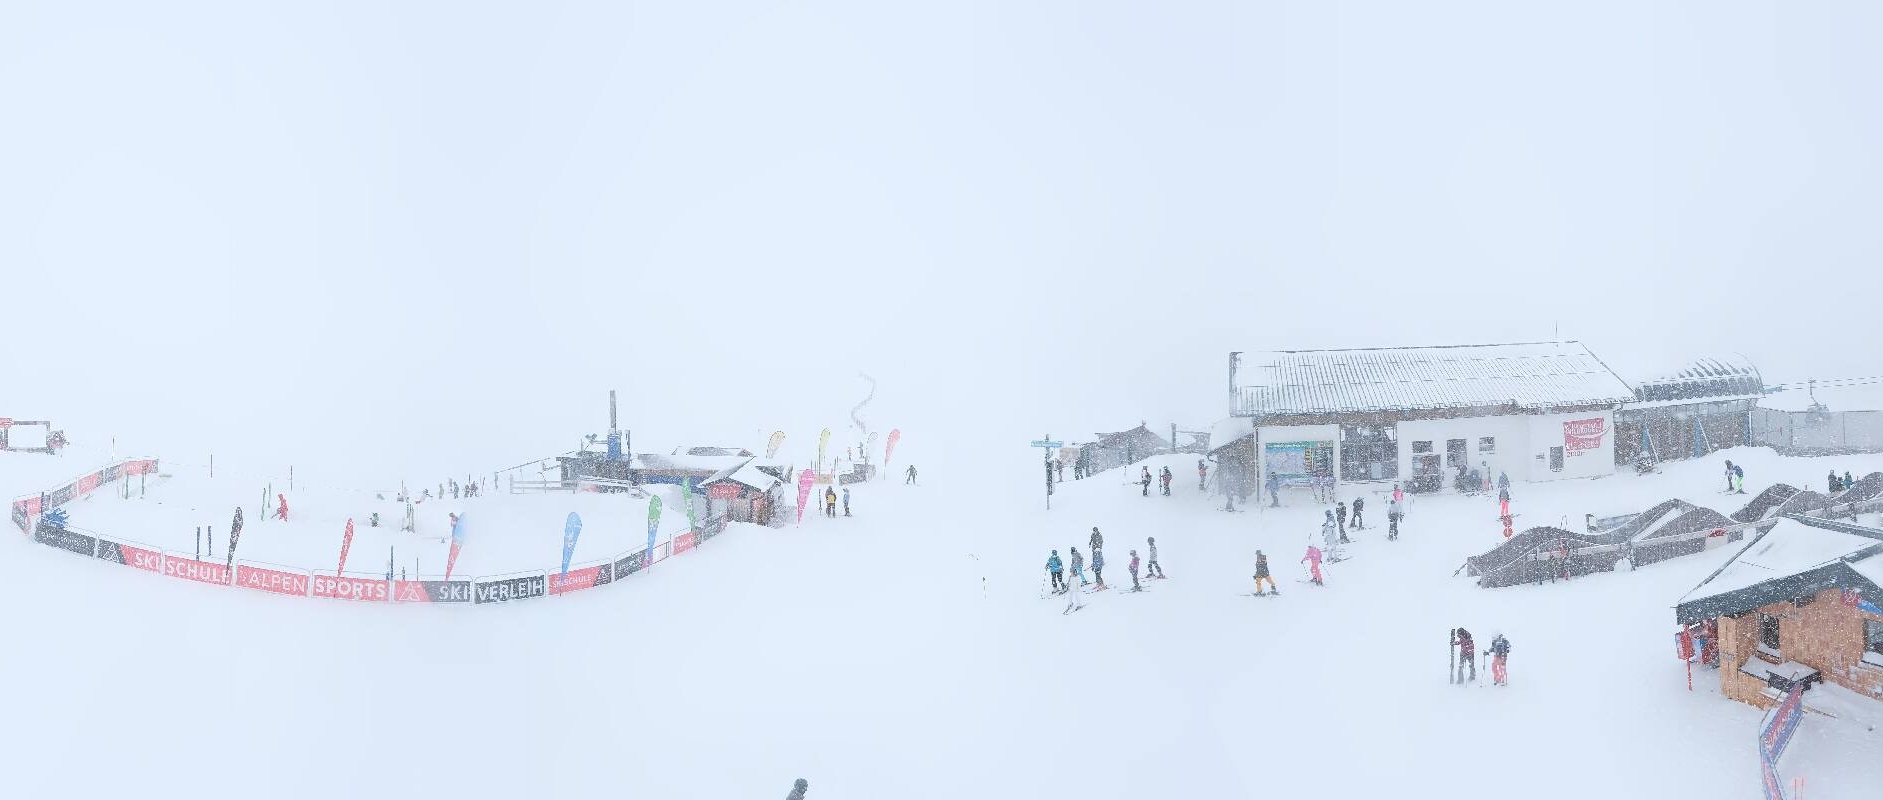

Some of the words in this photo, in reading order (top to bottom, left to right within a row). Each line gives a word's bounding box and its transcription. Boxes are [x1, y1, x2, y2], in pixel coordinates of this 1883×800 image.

[134, 552, 161, 572] SKI
[165, 560, 232, 584] SCHULE
[249, 572, 306, 592] ALPEN
[315, 578, 386, 598] SPORTS
[438, 584, 470, 601] SKI
[477, 578, 544, 602] VERLEIH
